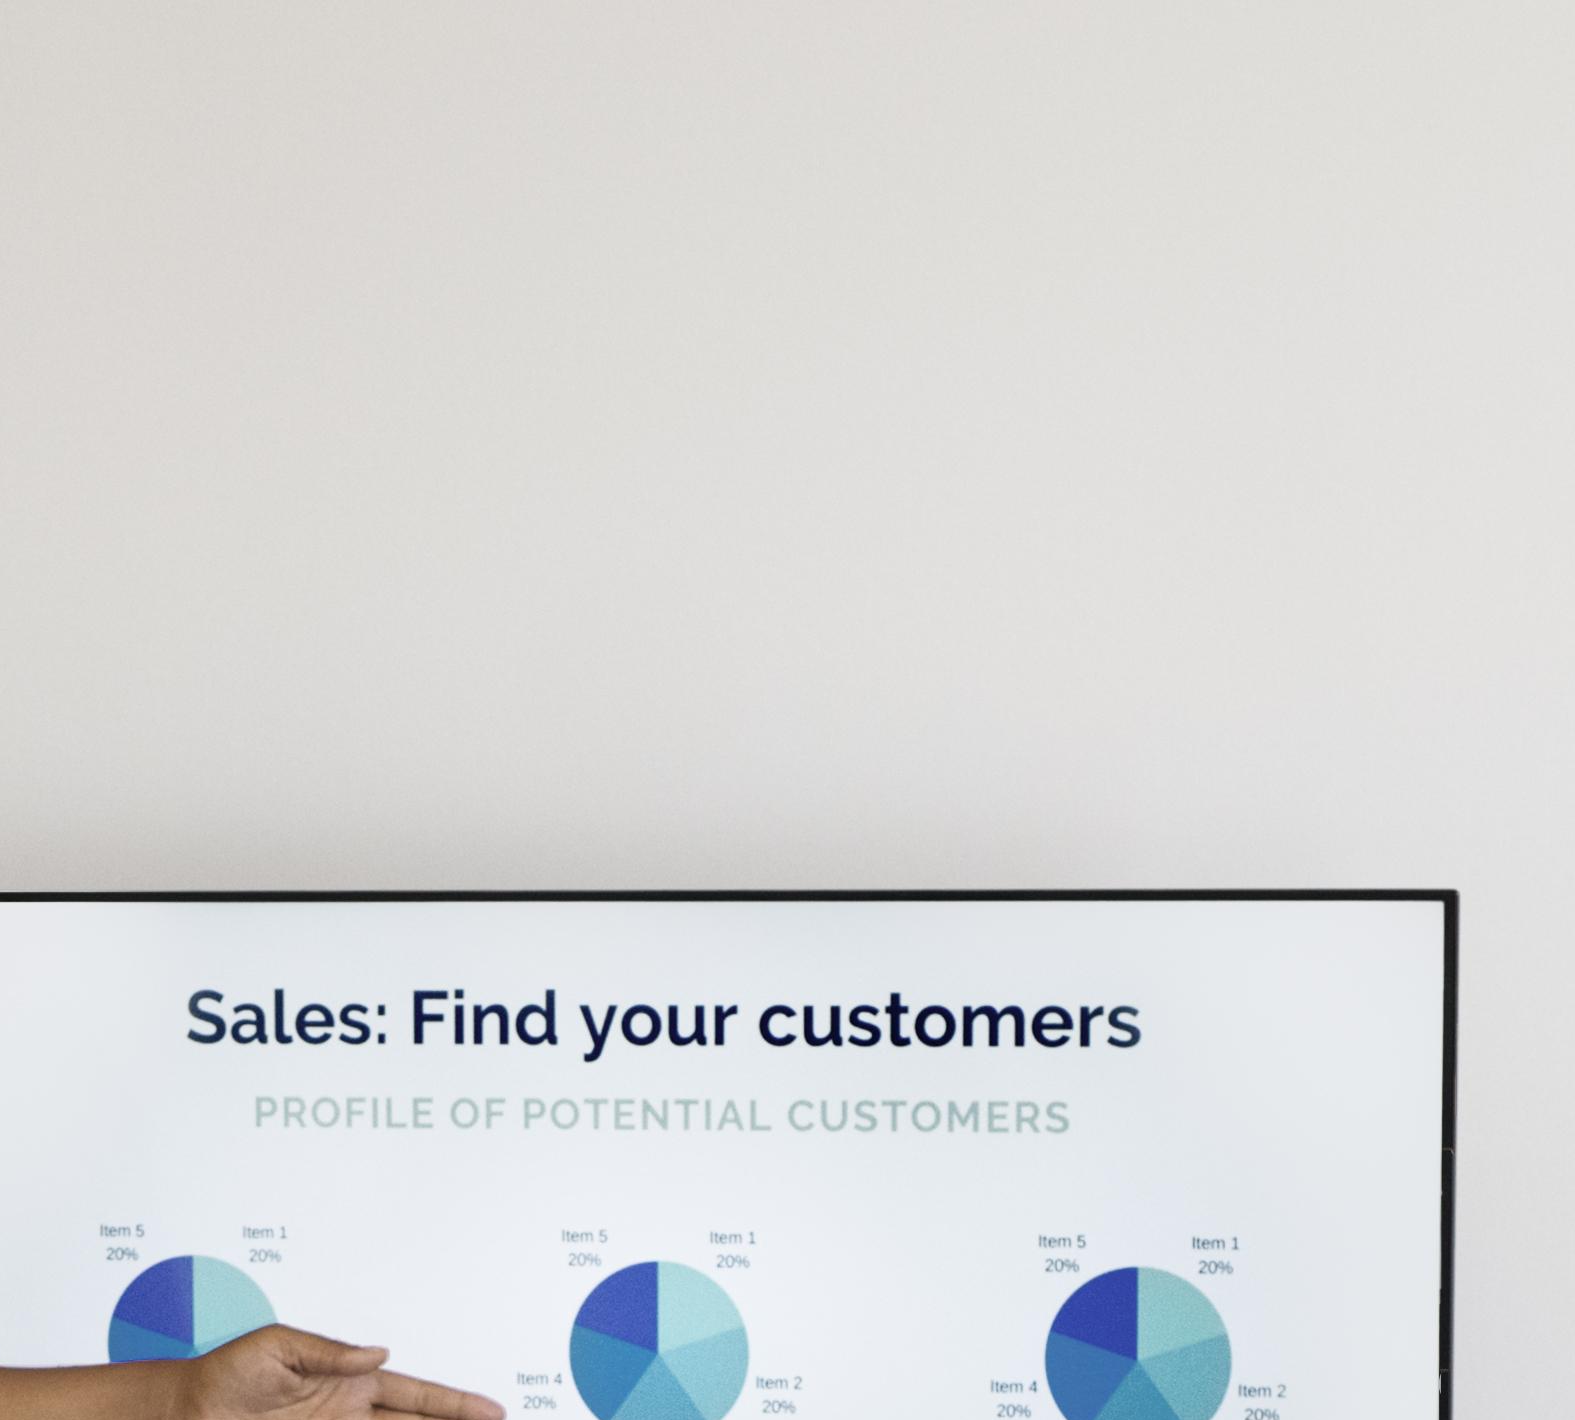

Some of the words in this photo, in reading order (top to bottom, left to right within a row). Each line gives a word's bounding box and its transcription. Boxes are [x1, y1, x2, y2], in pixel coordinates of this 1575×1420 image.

[186, 987, 387, 1046] Sales:
[412, 988, 559, 1047] Find
[579, 1003, 739, 1064] your
[758, 991, 1142, 1049] customers
[254, 1095, 434, 1130] PROFILE
[449, 1096, 507, 1130] OF
[522, 1097, 772, 1132] POTENTIAL
[786, 1098, 1071, 1135] CUSTOMERS
[98, 1223, 132, 1239] Item
[134, 1222, 146, 1239] 5
[241, 1225, 276, 1240] Item
[279, 1225, 288, 1241] 1
[560, 1229, 595, 1244] Item
[597, 1228, 609, 1244] 5
[708, 1230, 744, 1246] Item
[748, 1230, 757, 1246] 1
[1037, 1234, 1073, 1249] Item
[1075, 1233, 1088, 1250] 5
[1190, 1235, 1227, 1251] Item
[1231, 1235, 1240, 1252] 1
[105, 1245, 140, 1262] 20%
[248, 1247, 283, 1264] 20%
[567, 1251, 603, 1268] 20%
[715, 1253, 751, 1270] 20%
[1044, 1257, 1081, 1274] 20%
[1197, 1259, 1235, 1276] 20%
[516, 1371, 550, 1386] Item
[553, 1372, 564, 1386] 4
[754, 1375, 790, 1390] Item
[792, 1375, 804, 1391] 2
[989, 1379, 1025, 1395] Item
[1028, 1379, 1039, 1394] 4
[1237, 1383, 1273, 1399] Item
[1276, 1383, 1287, 1400] 2
[522, 1394, 558, 1410] 20%
[761, 1398, 798, 1415] 20%
[996, 1402, 1033, 1419] 20%
